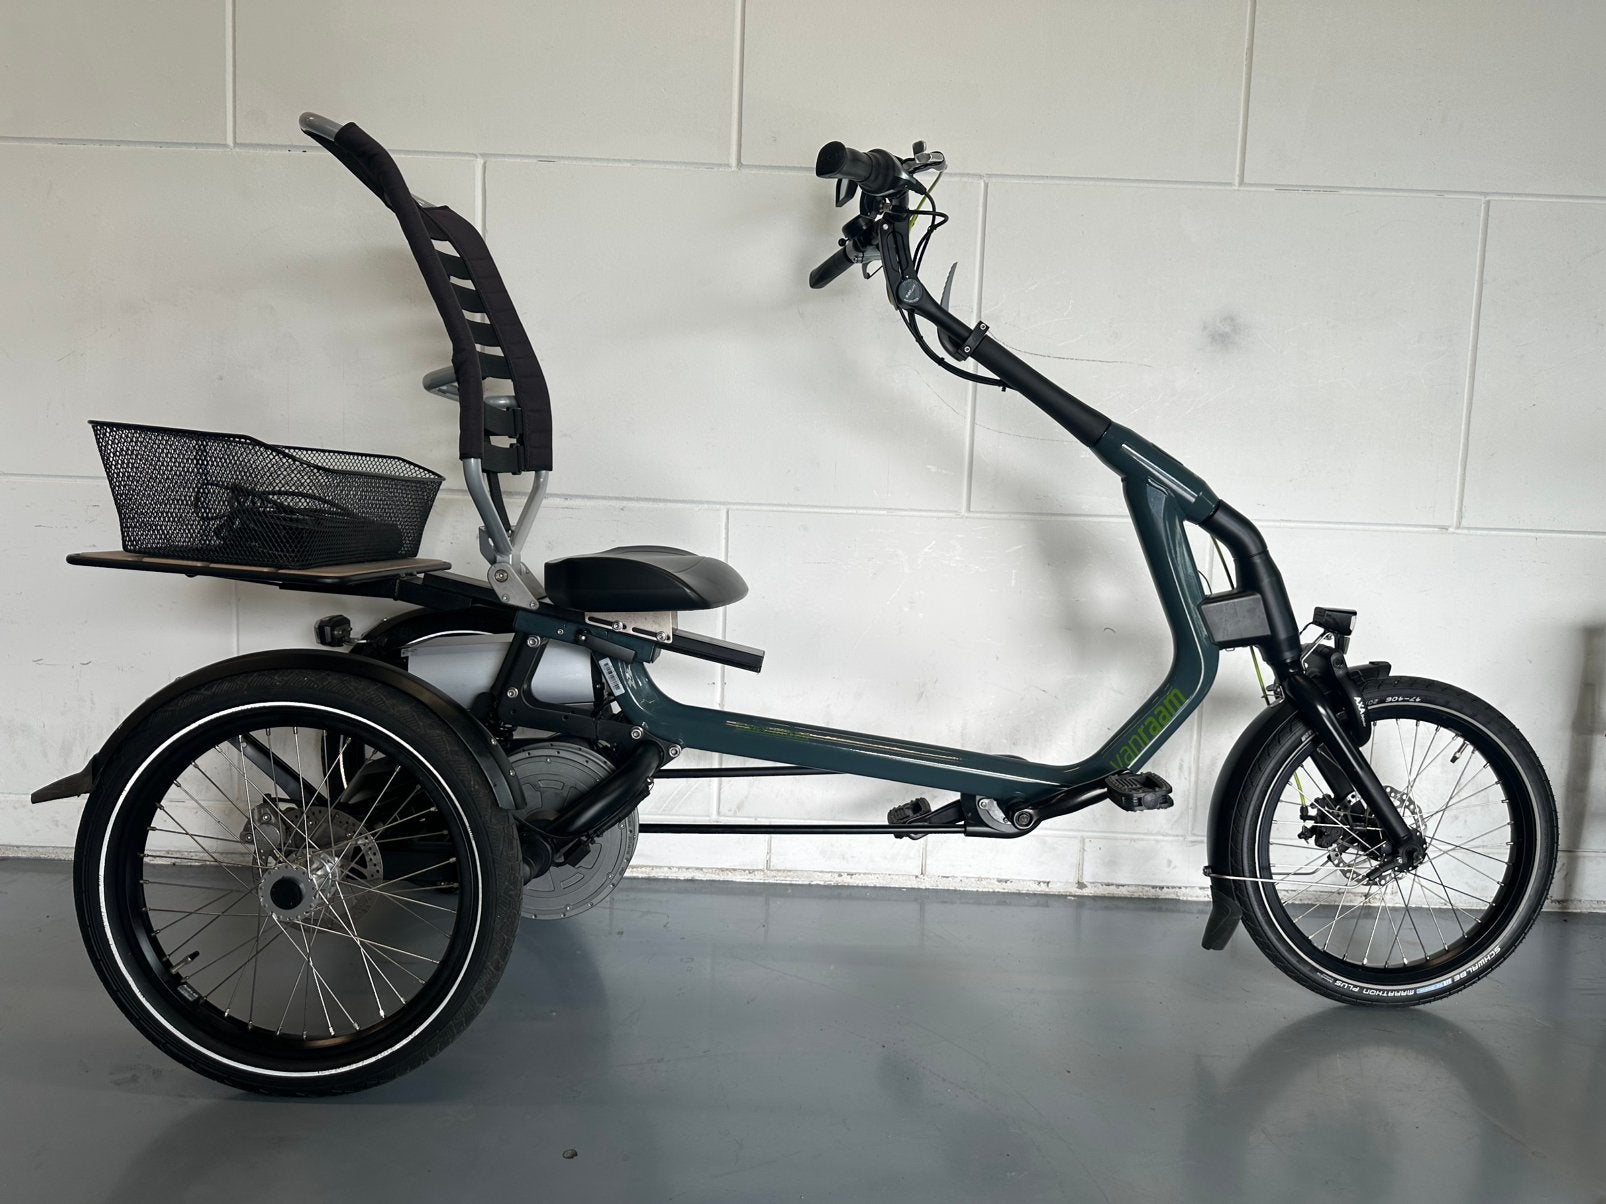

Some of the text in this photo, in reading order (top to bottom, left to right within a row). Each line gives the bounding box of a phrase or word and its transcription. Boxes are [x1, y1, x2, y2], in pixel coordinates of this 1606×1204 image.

[1353, 696, 1367, 715] AXA
[1385, 696, 1422, 704] 47-406
[1110, 688, 1185, 769] vanraam
[1454, 947, 1501, 982] SCHWALBE
[1334, 979, 1415, 997] MARATHON PLUS
